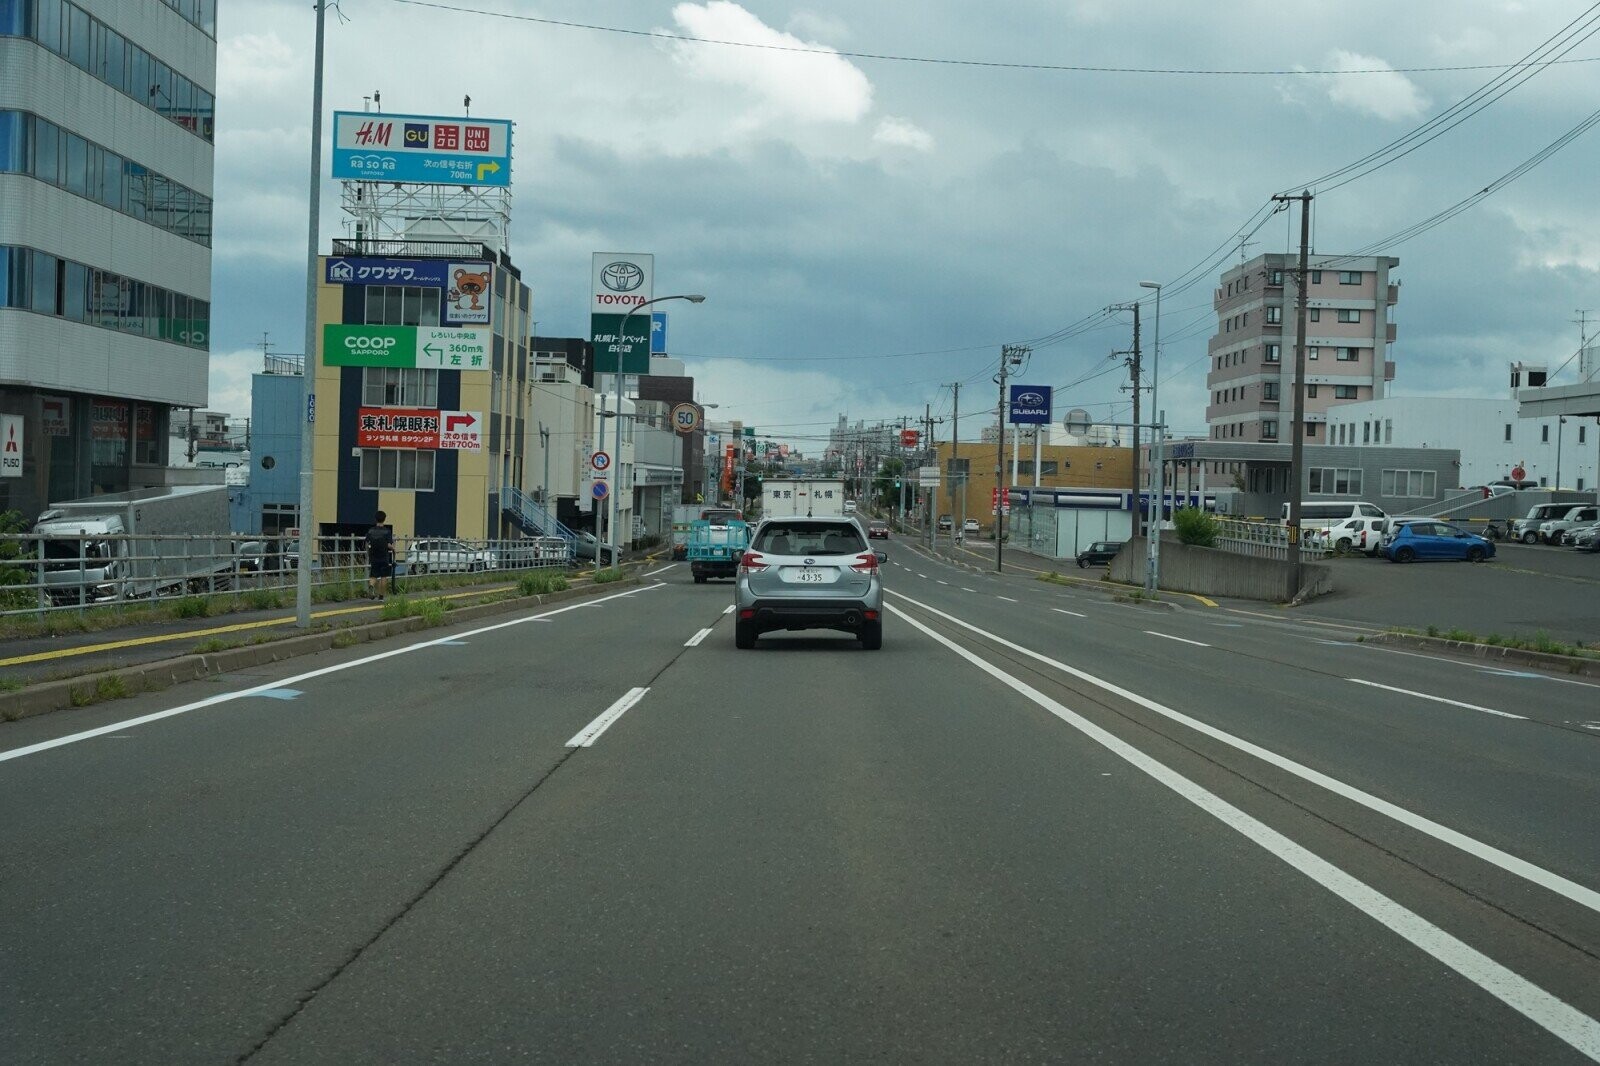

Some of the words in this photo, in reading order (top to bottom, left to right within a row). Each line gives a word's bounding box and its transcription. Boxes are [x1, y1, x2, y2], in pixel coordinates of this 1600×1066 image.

[355, 121, 392, 147] H&M
[405, 129, 429, 142] GU
[467, 129, 486, 139] UNI
[467, 139, 487, 149] QLO
[423, 159, 473, 170] 次の信号右折
[450, 171, 473, 179] 700m
[357, 266, 415, 280] クワザワ
[596, 294, 647, 305] TOYOTA
[431, 331, 477, 340] しろいし中央店
[344, 336, 396, 349] COOP
[449, 343, 484, 353] 360m先
[678, 411, 693, 425] 50
[361, 414, 439, 433] 東札幌眼科
[443, 432, 478, 440] 次の信号
[441, 440, 480, 448] 右折700m
[3, 458, 20, 467] FUSO
[772, 490, 791, 499] 東京
[814, 490, 833, 499] 札幌
